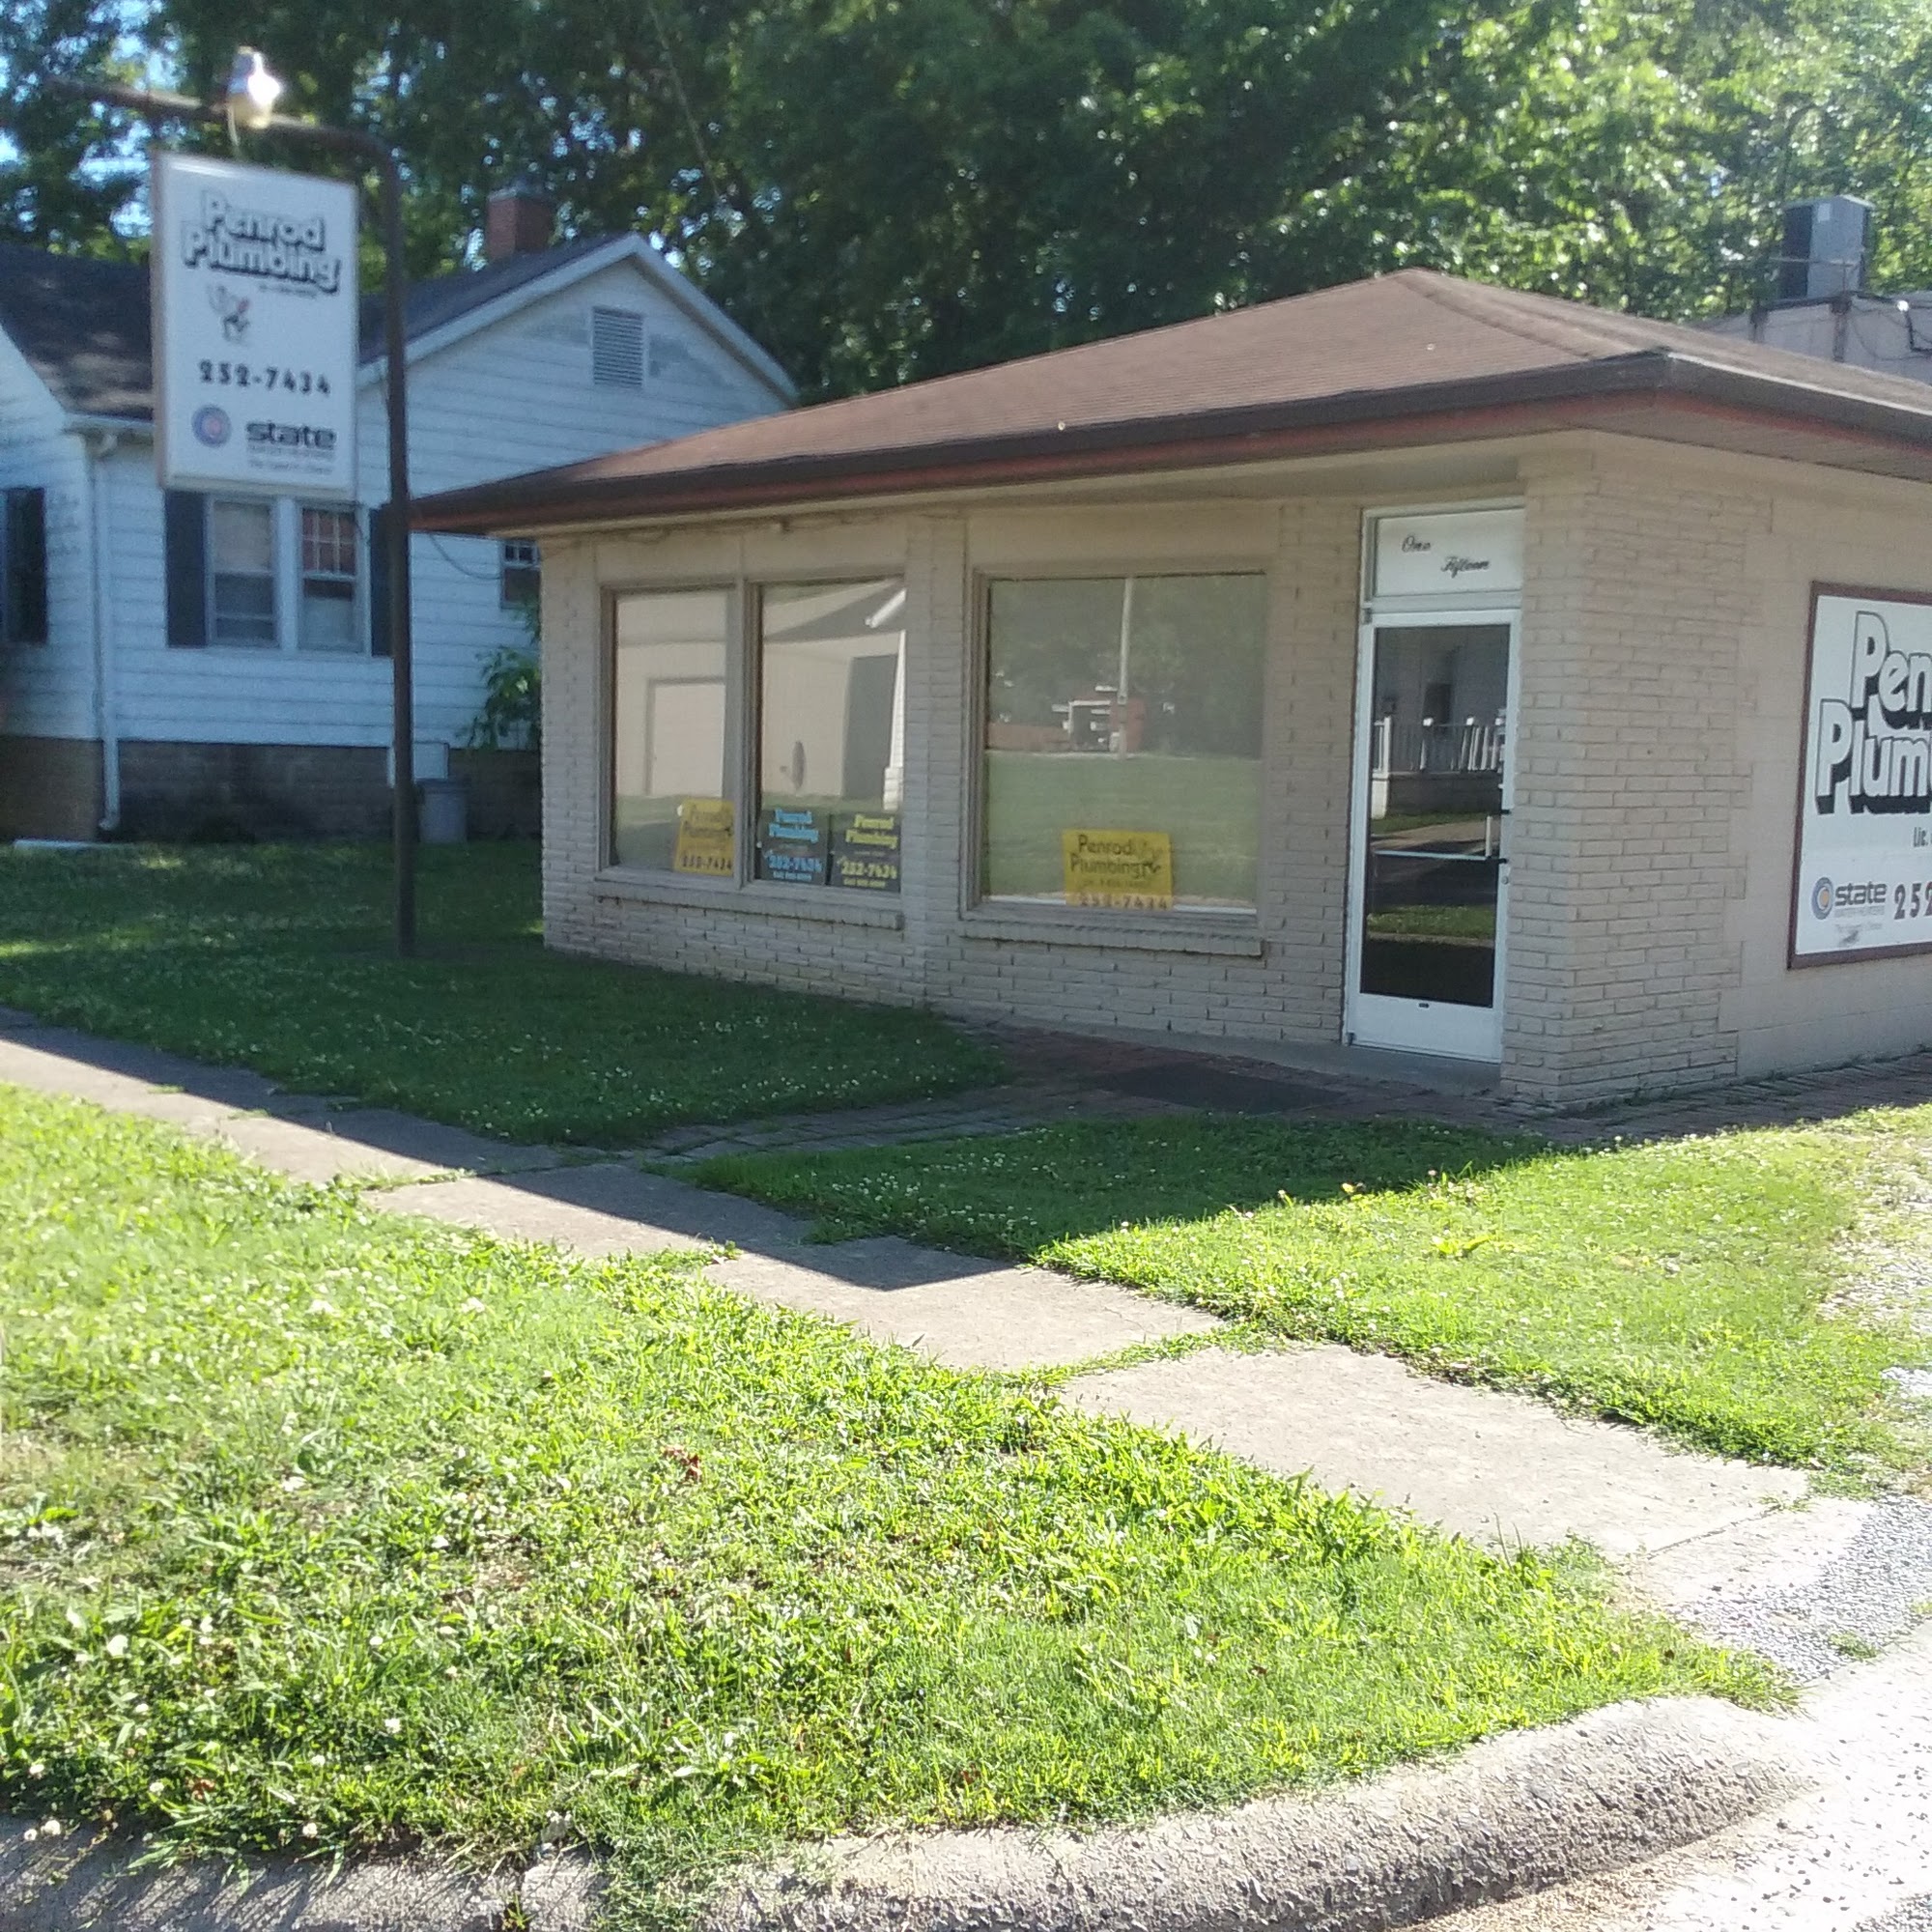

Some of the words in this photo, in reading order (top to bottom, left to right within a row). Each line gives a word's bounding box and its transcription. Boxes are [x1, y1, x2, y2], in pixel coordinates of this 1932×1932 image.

[200, 189, 325, 252] Penrod
[181, 220, 340, 294] Plumbing
[246, 421, 336, 450] state
[1402, 535, 1431, 553] One
[1440, 556, 1490, 579] Fifteen
[1078, 834, 1132, 856] Penrod
[1834, 881, 1887, 906] state
